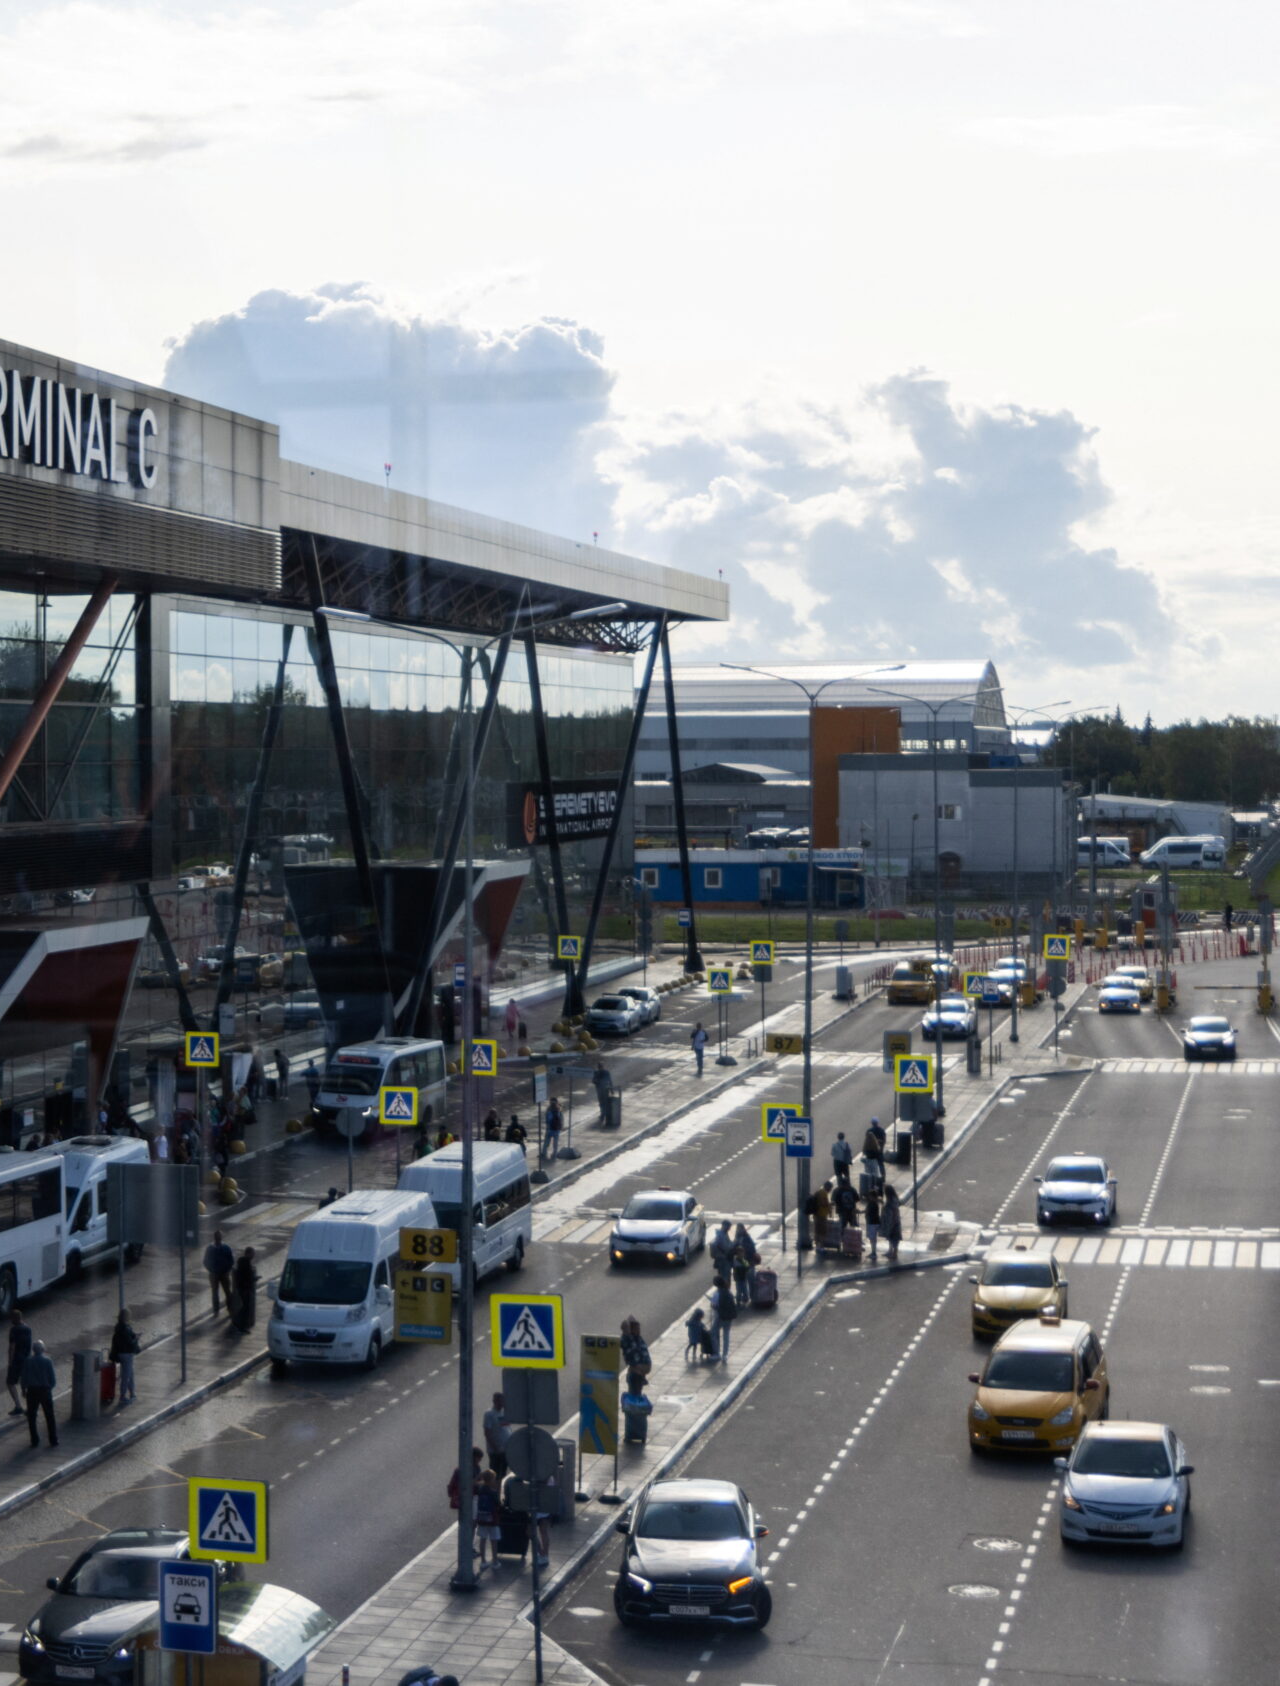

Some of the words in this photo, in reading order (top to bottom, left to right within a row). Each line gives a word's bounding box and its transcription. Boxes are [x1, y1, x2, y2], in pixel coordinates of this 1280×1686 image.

[138, 407, 158, 489] C
[540, 791, 617, 818] SEREMETYEVO
[774, 1036, 794, 1049] 87
[411, 1234, 445, 1257] 88
[169, 1576, 206, 1588] такси
